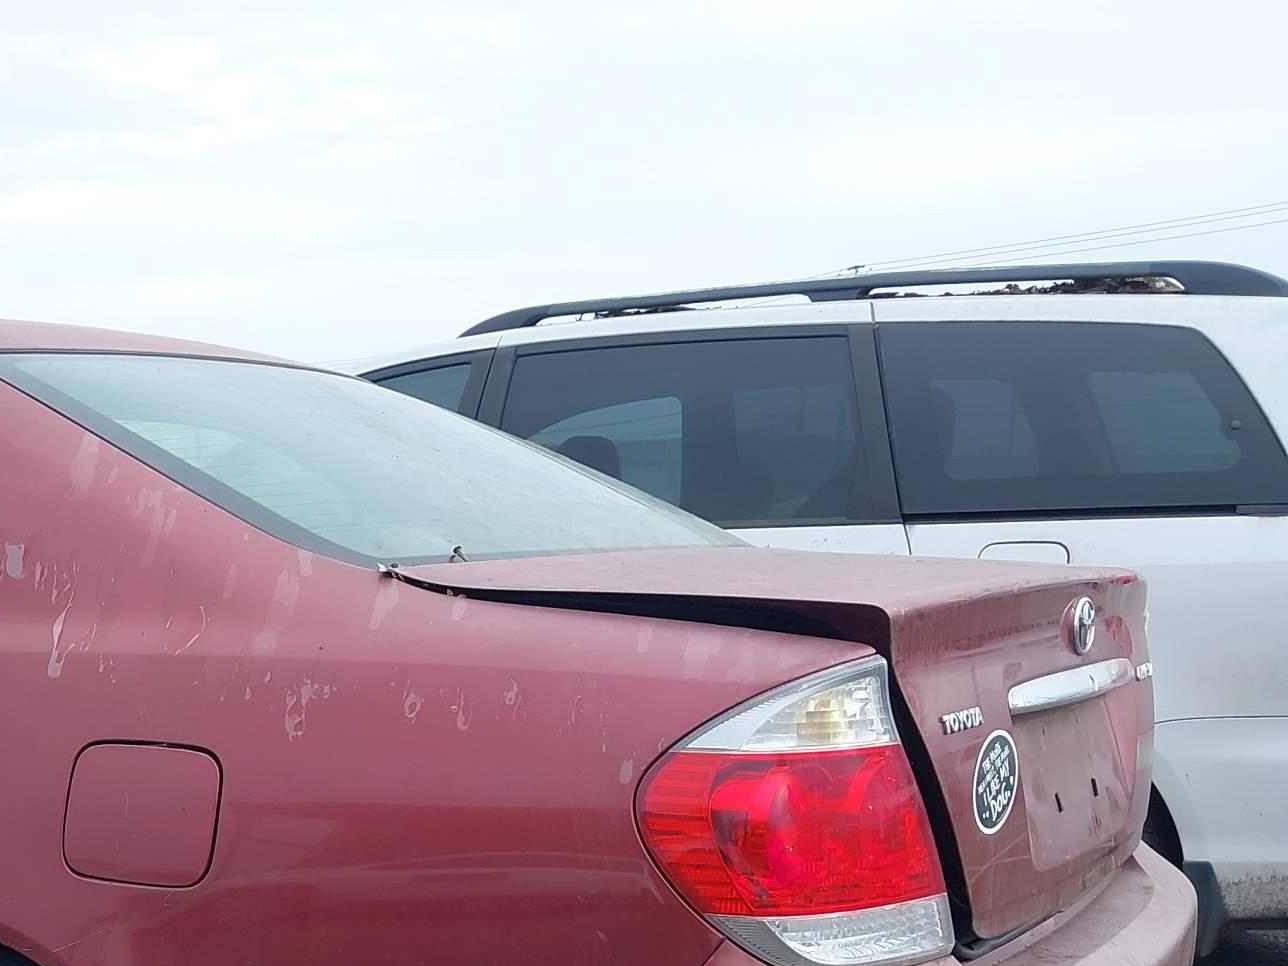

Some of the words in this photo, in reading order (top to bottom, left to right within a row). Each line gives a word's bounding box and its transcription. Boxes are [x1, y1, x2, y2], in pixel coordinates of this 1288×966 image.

[941, 706, 984, 735] TOYOTA
[986, 774, 1001, 799] LIKE
[999, 757, 1010, 782] MY
